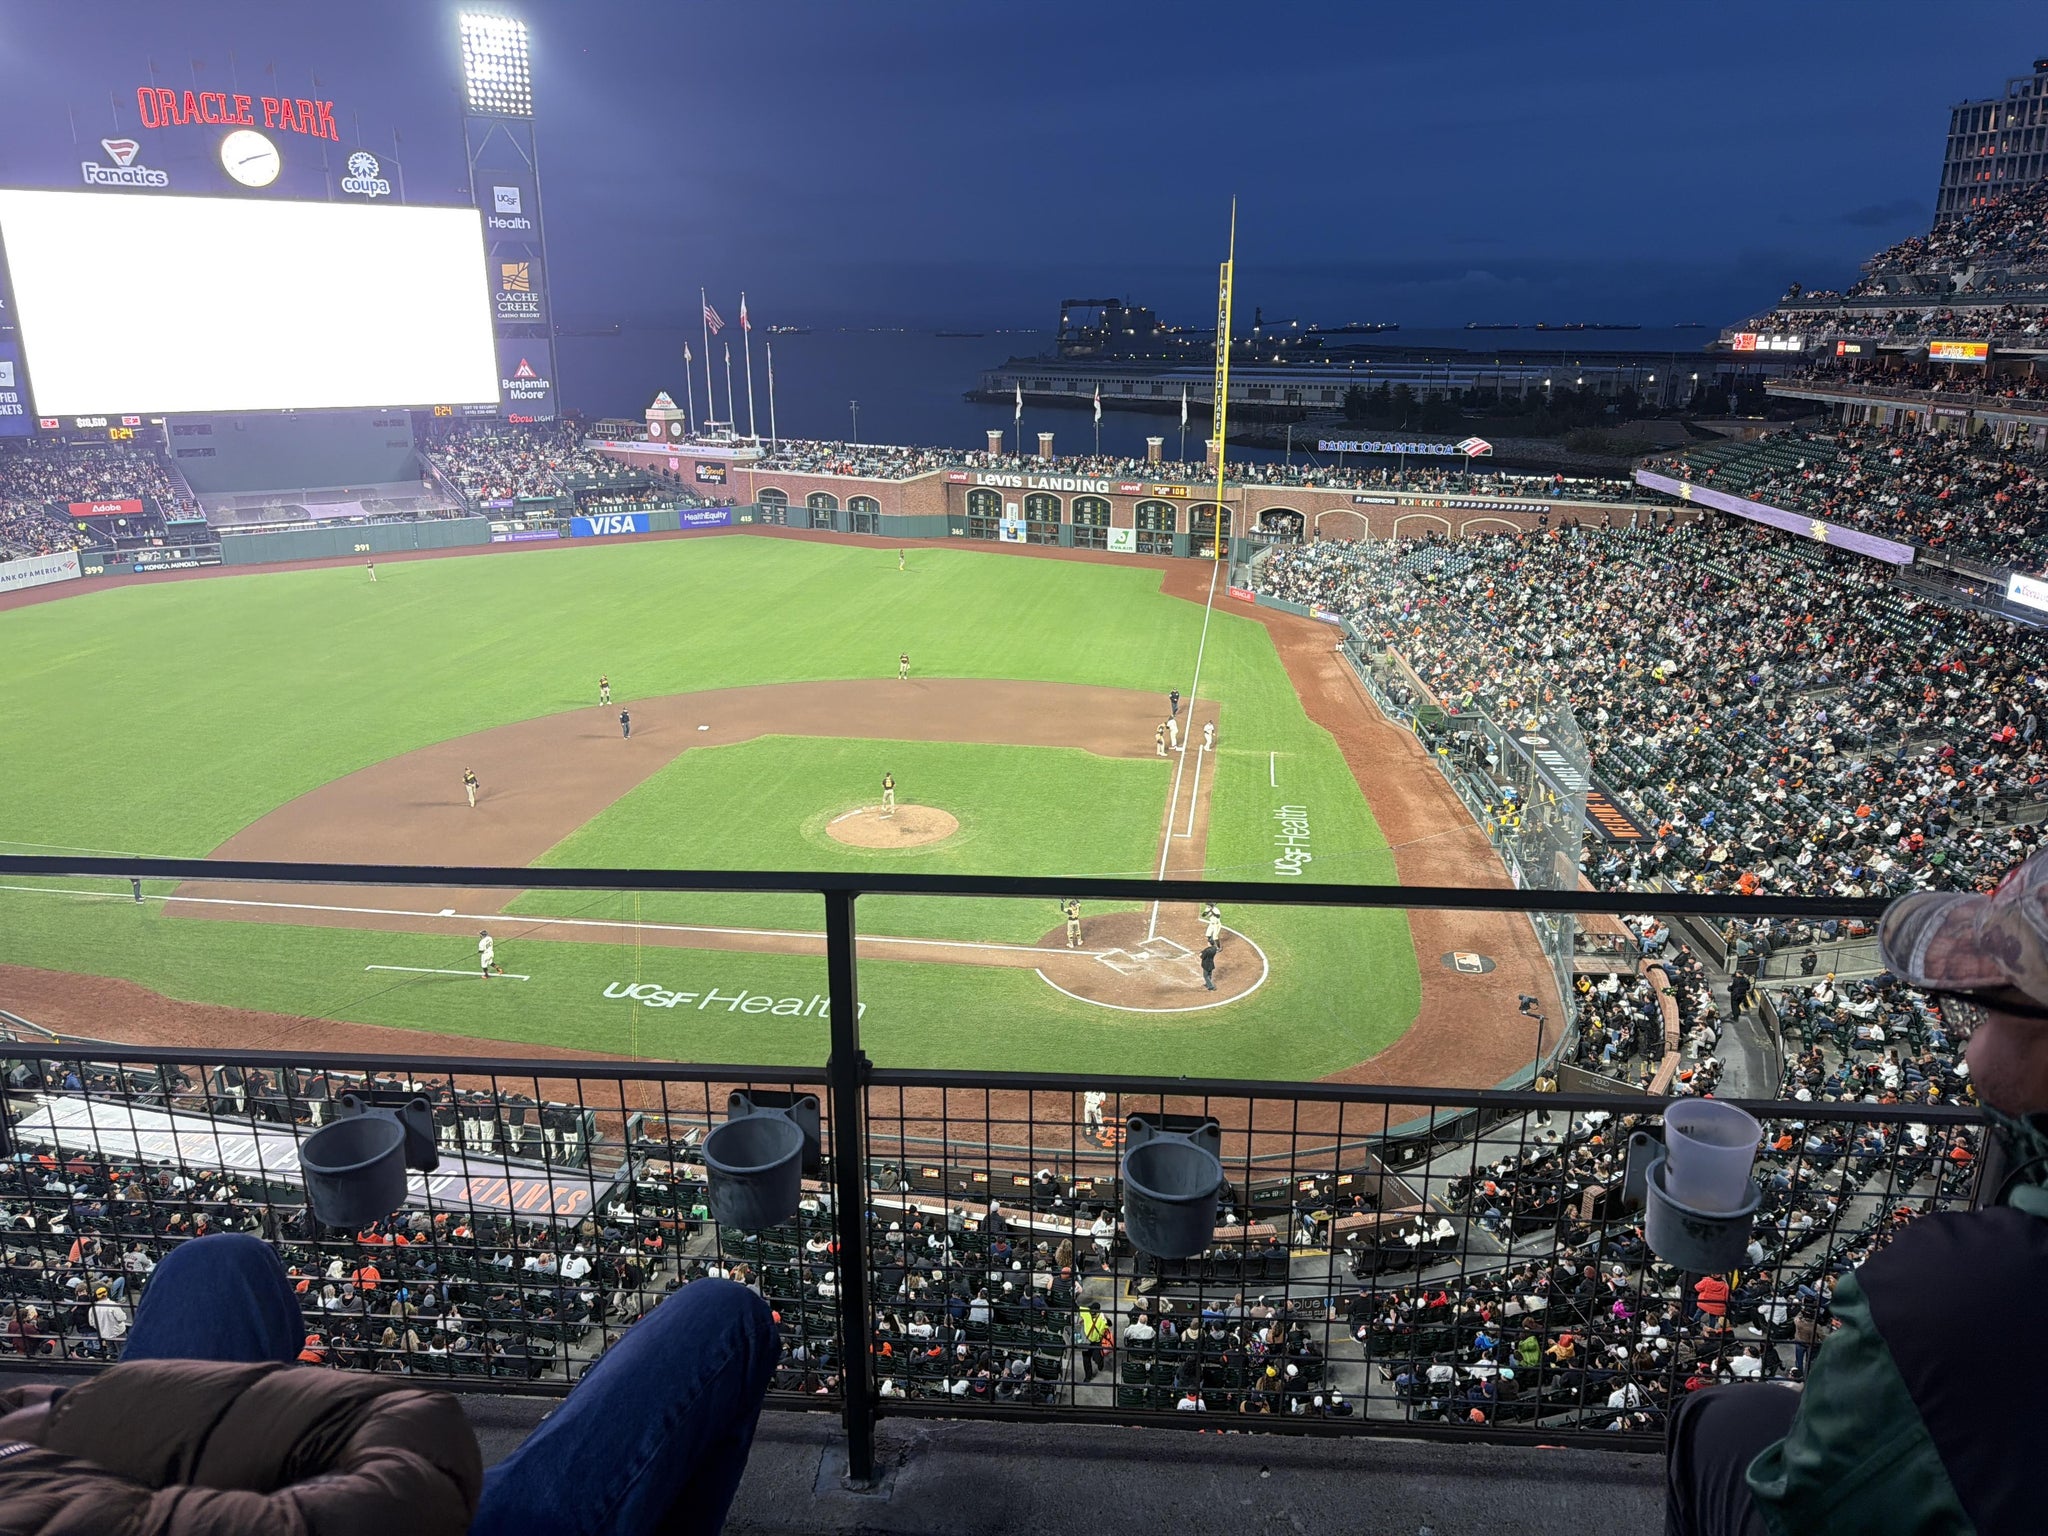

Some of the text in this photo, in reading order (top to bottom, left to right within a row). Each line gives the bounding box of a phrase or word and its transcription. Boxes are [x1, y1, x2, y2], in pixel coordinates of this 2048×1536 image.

[137, 87, 339, 141] ORACLE PARK
[82, 163, 168, 186] Fanatics
[342, 177, 389, 197] coupa
[497, 194, 517, 206] UCSF
[488, 216, 531, 229] Health
[496, 292, 539, 302] CACHE
[498, 302, 538, 312] CREEK
[502, 379, 549, 391] Benjamin
[510, 390, 544, 400] Moore
[434, 405, 452, 416] 0:24
[508, 413, 533, 423] Coors
[109, 427, 134, 441] 0:24
[1318, 440, 1453, 455] BANK OF AMERICA
[1028, 475, 1109, 493] LANDING
[92, 504, 122, 514] Adobe
[684, 511, 727, 520] HealthEquity
[585, 516, 636, 535] VISA
[951, 528, 964, 536] 365
[355, 544, 370, 552] 391
[1200, 549, 1215, 558] 309
[29, 566, 62, 577] AMERICA
[84, 565, 104, 575] 399
[144, 563, 170, 571] KONICA
[171, 561, 199, 569] MINOLTA
[1273, 805, 1312, 876] UCSF Health
[602, 982, 867, 1020] UCSF Healt
[201, 1136, 278, 1166] SAN
[459, 1177, 588, 1215] GIANTS
